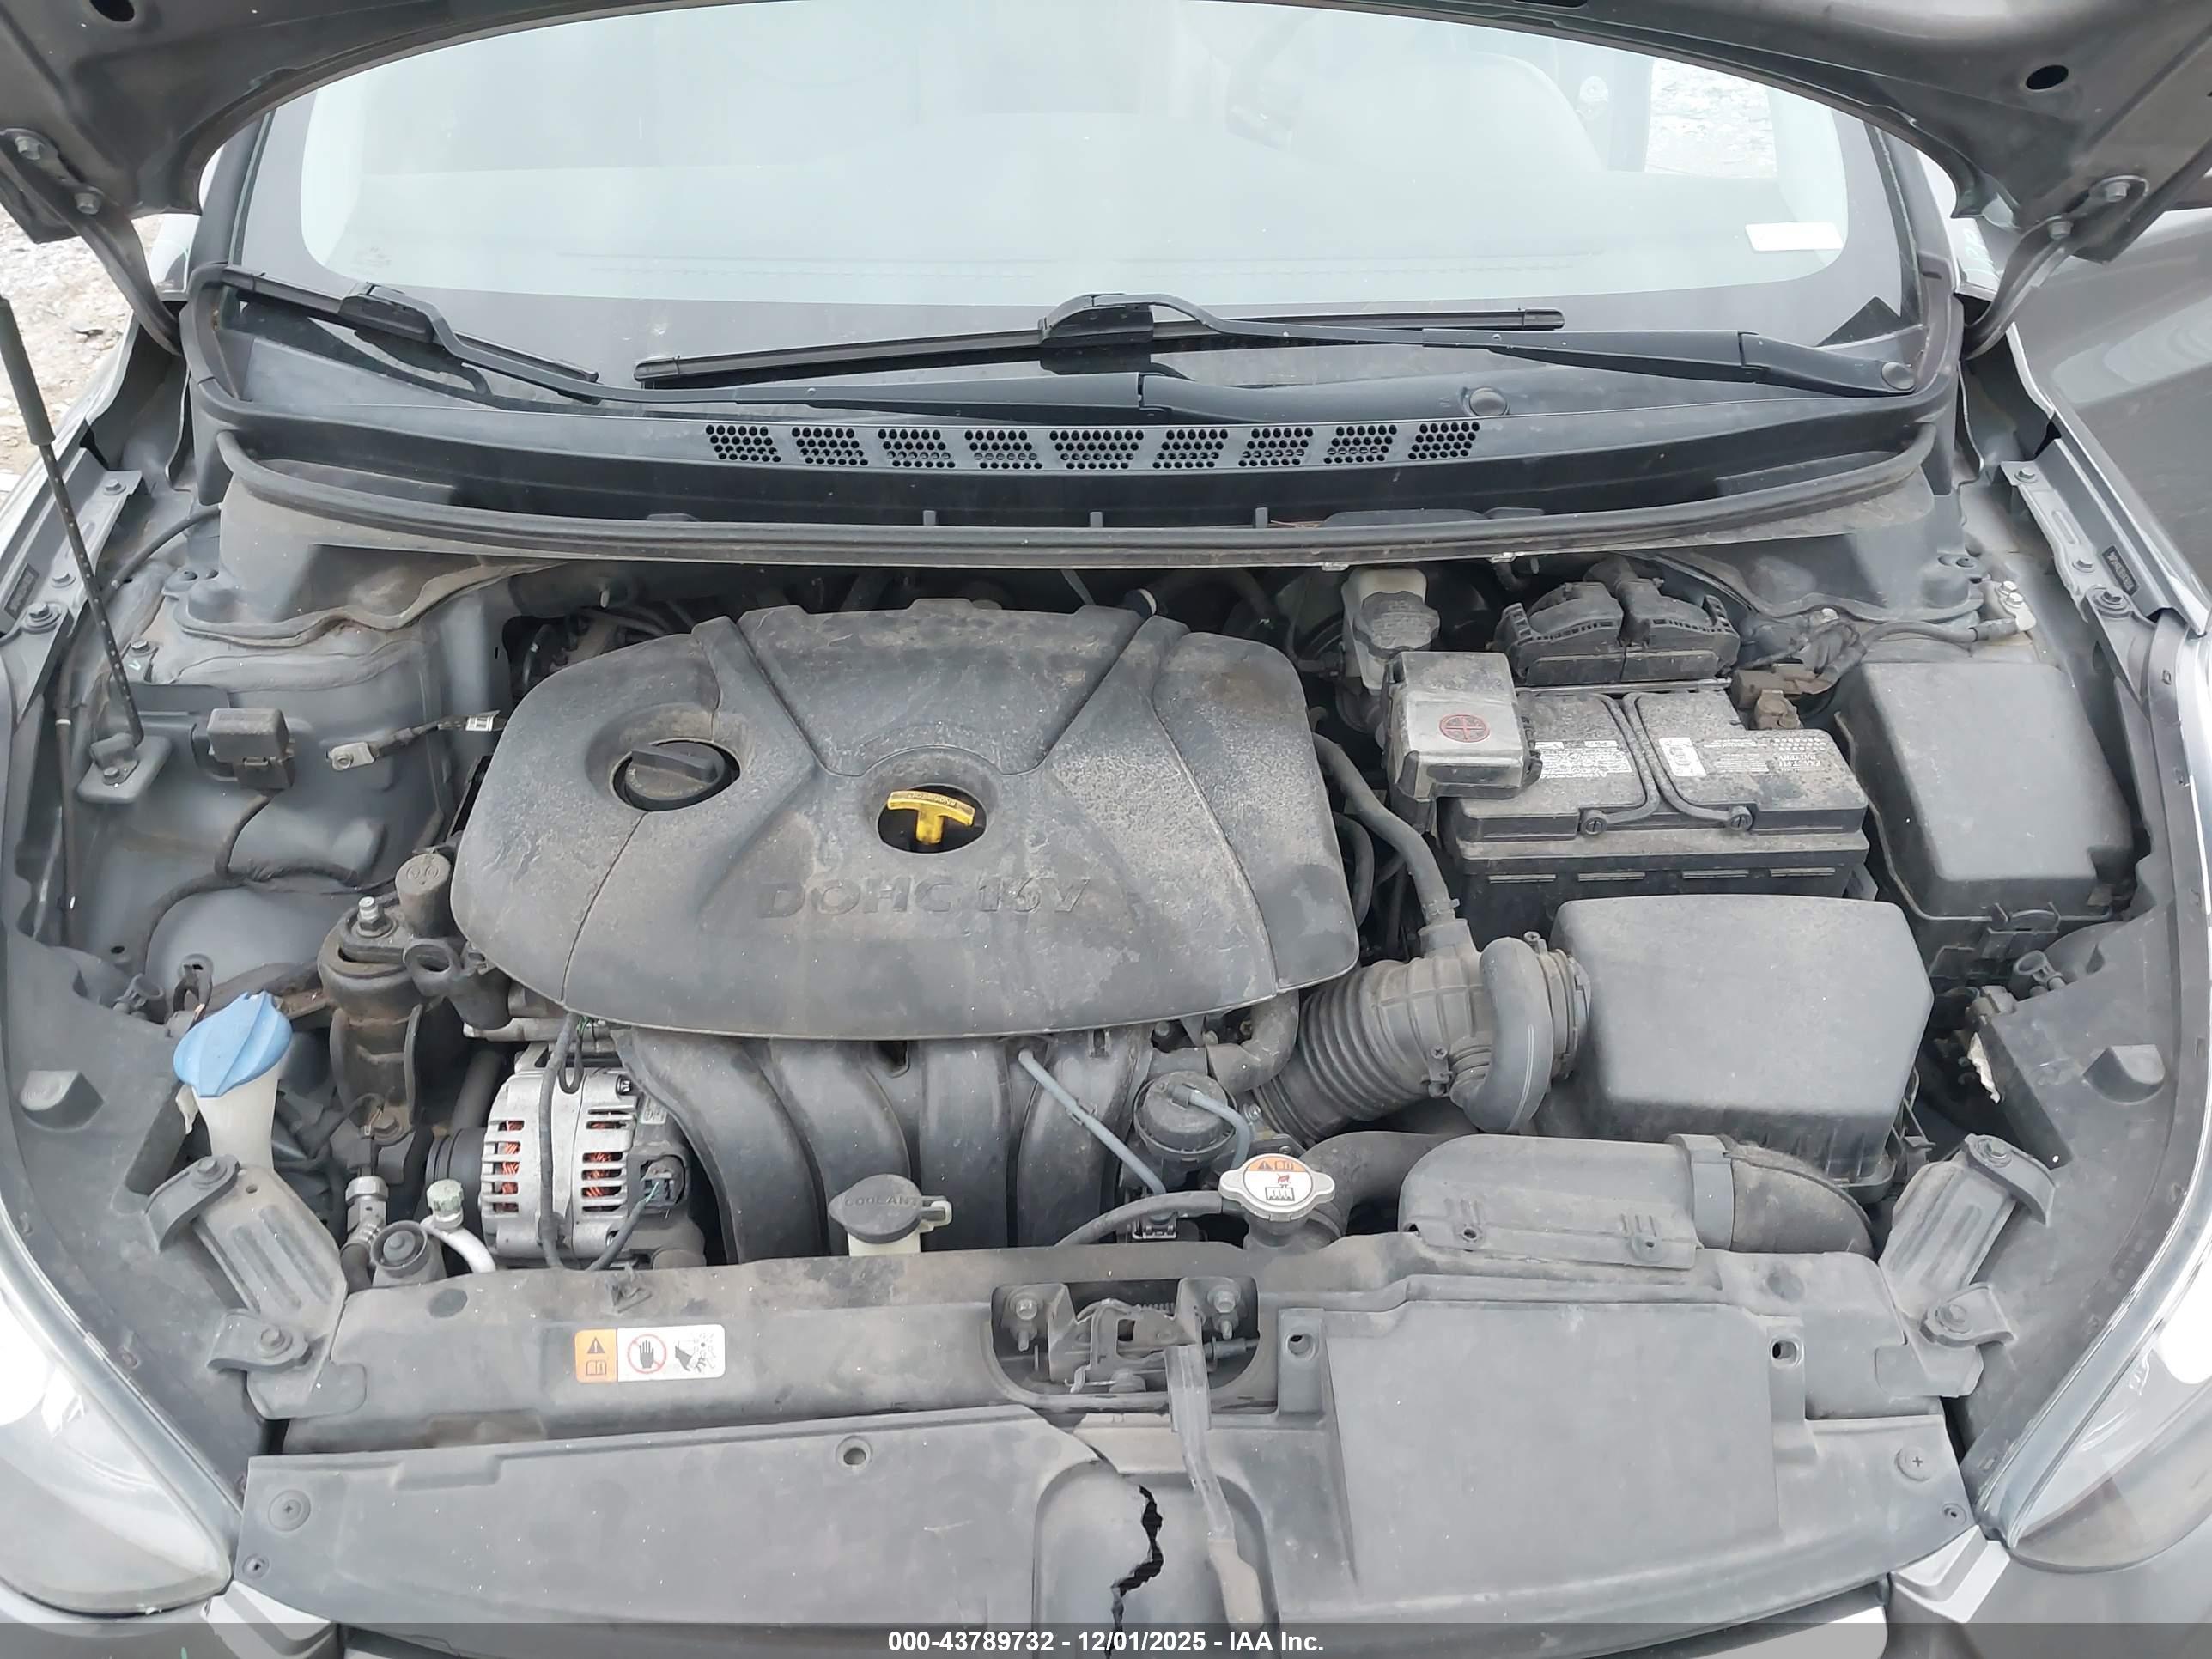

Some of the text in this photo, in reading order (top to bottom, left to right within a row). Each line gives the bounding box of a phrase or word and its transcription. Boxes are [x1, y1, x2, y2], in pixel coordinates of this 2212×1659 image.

[757, 876, 1091, 919] DOHC 16V
[845, 1194, 918, 1208] COOLANT
